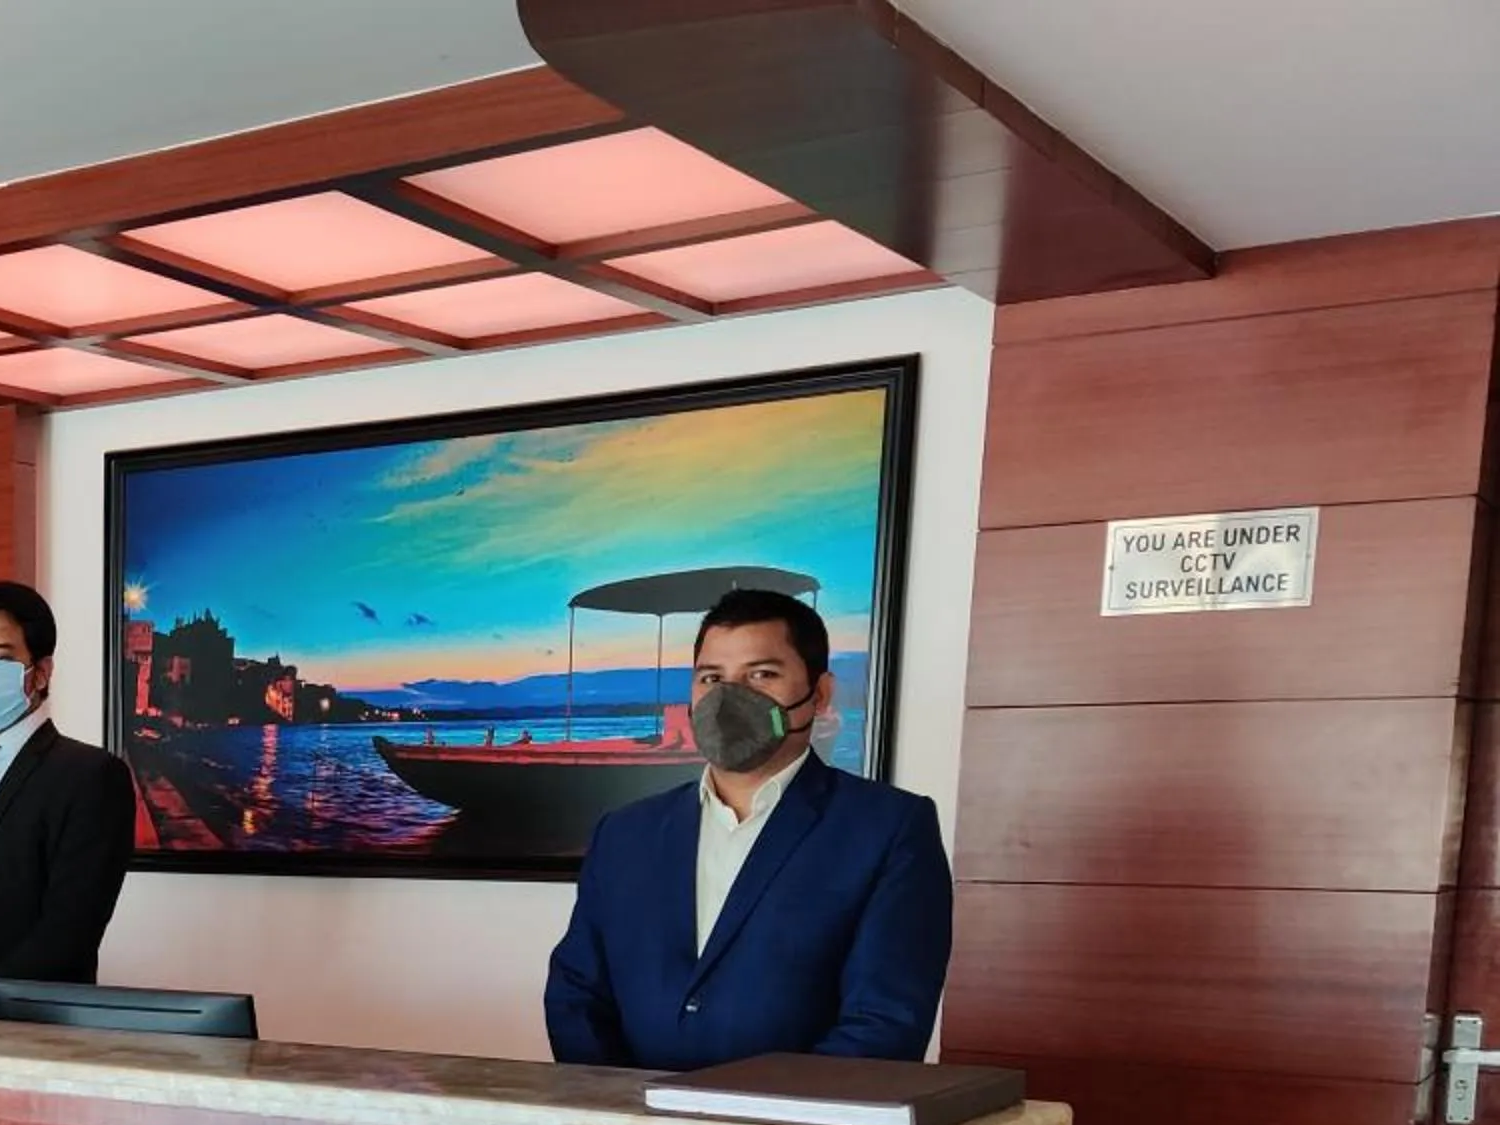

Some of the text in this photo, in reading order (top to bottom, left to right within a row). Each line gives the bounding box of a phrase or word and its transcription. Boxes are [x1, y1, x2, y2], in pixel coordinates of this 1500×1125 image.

[1123, 524, 1301, 553] YOU ARE UNDER
[1180, 552, 1237, 573] CCTV
[1125, 573, 1290, 600] SURVEILLANCE
